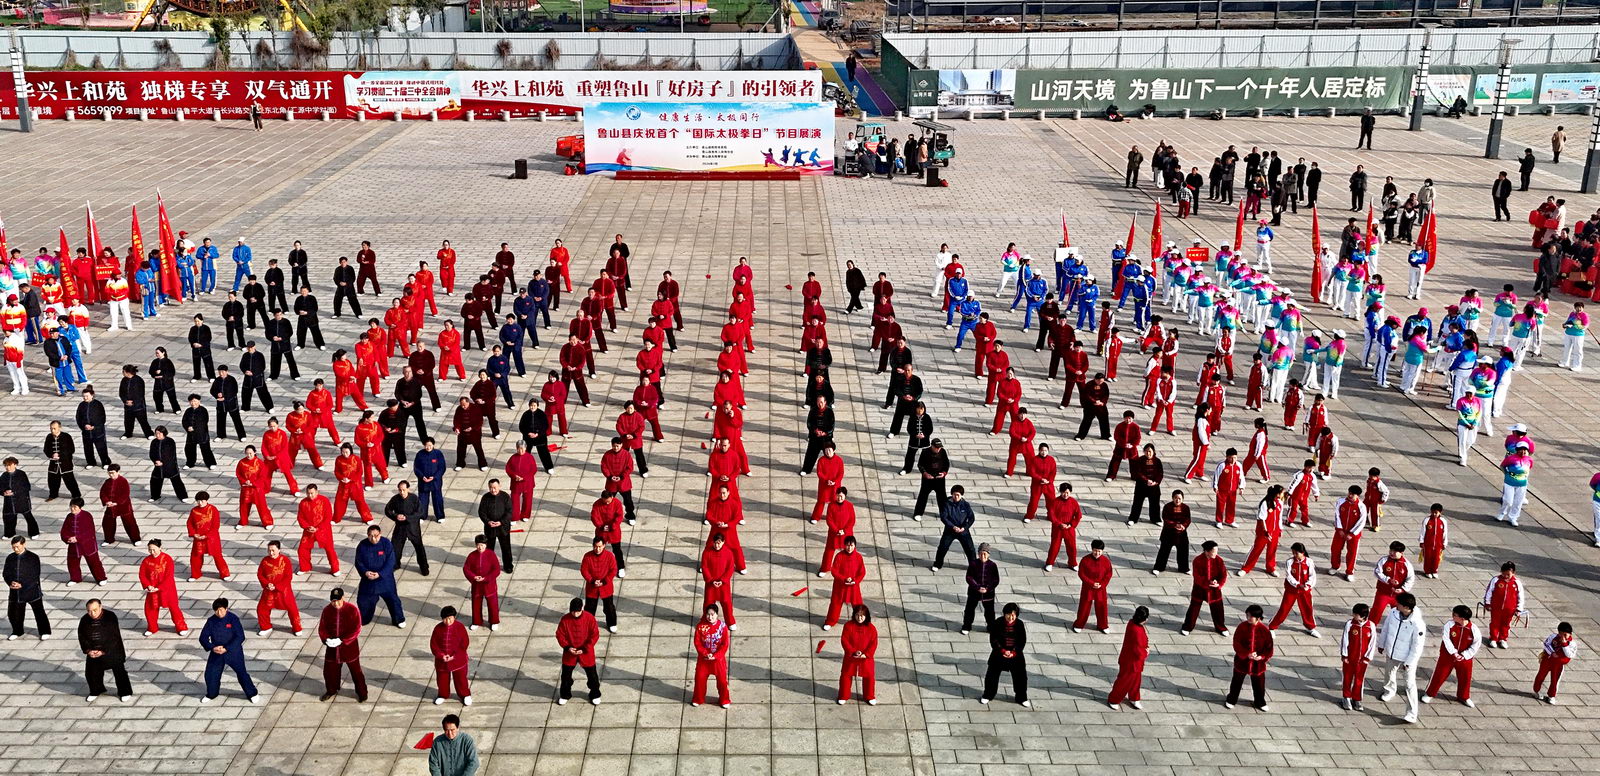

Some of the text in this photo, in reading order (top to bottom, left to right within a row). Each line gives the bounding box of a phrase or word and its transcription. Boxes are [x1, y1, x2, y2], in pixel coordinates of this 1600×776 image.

[140, 79, 231, 101] 独梯专享
[244, 79, 334, 101] 双气通开
[471, 79, 564, 97] 华兴上和苑
[1030, 76, 1387, 102] 山河天境 为鲁山下一个十年人居定标
